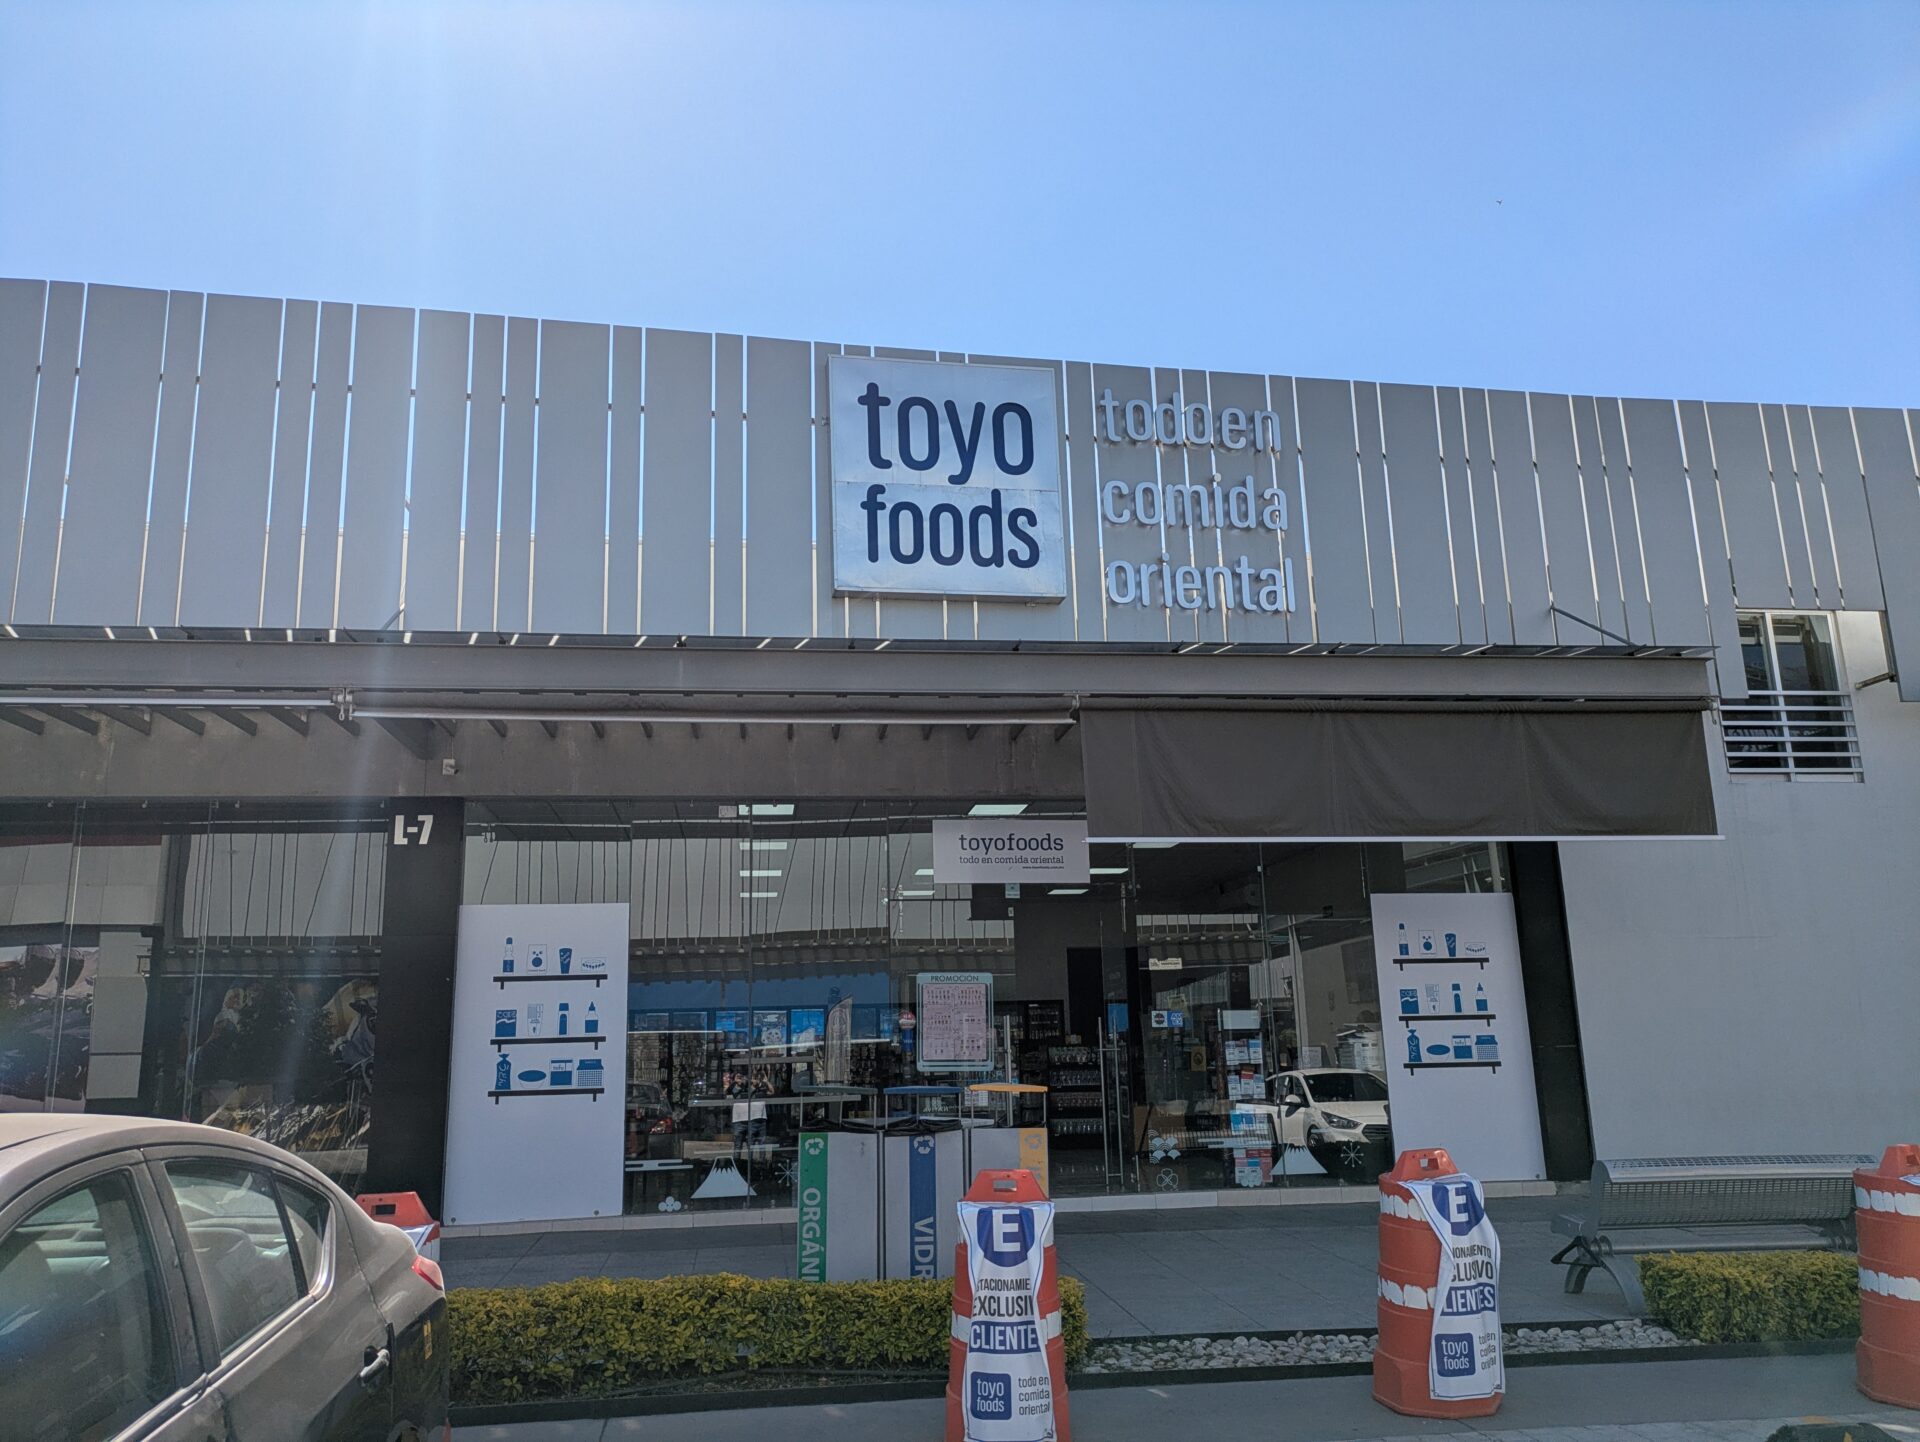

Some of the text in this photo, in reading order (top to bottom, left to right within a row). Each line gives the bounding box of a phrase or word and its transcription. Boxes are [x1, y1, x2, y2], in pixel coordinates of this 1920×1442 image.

[857, 382, 1034, 485] toyo
[1100, 388, 1282, 450] todo en
[1103, 475, 1288, 530] comida
[860, 484, 1040, 568] foods
[1106, 552, 1297, 613] oriental
[393, 814, 434, 845] L-7
[959, 833, 1064, 855] toyofoods
[959, 855, 979, 864] todo
[994, 855, 1029, 864] comida
[1030, 855, 1065, 864] oriental
[1449, 1183, 1469, 1223] E
[802, 1187, 825, 1283] ORGÁNI
[992, 1209, 1021, 1252] E
[914, 1216, 935, 1280] VIDR
[1444, 1286, 1494, 1313] LIENTES
[970, 1325, 1038, 1350] CLIENTE
[1441, 1339, 1469, 1357] toyo
[1443, 1355, 1470, 1370] foods
[976, 1378, 1005, 1399] toyo
[1018, 1376, 1050, 1388] todo en
[1018, 1388, 1050, 1402] comida
[976, 1396, 1005, 1412] foods
